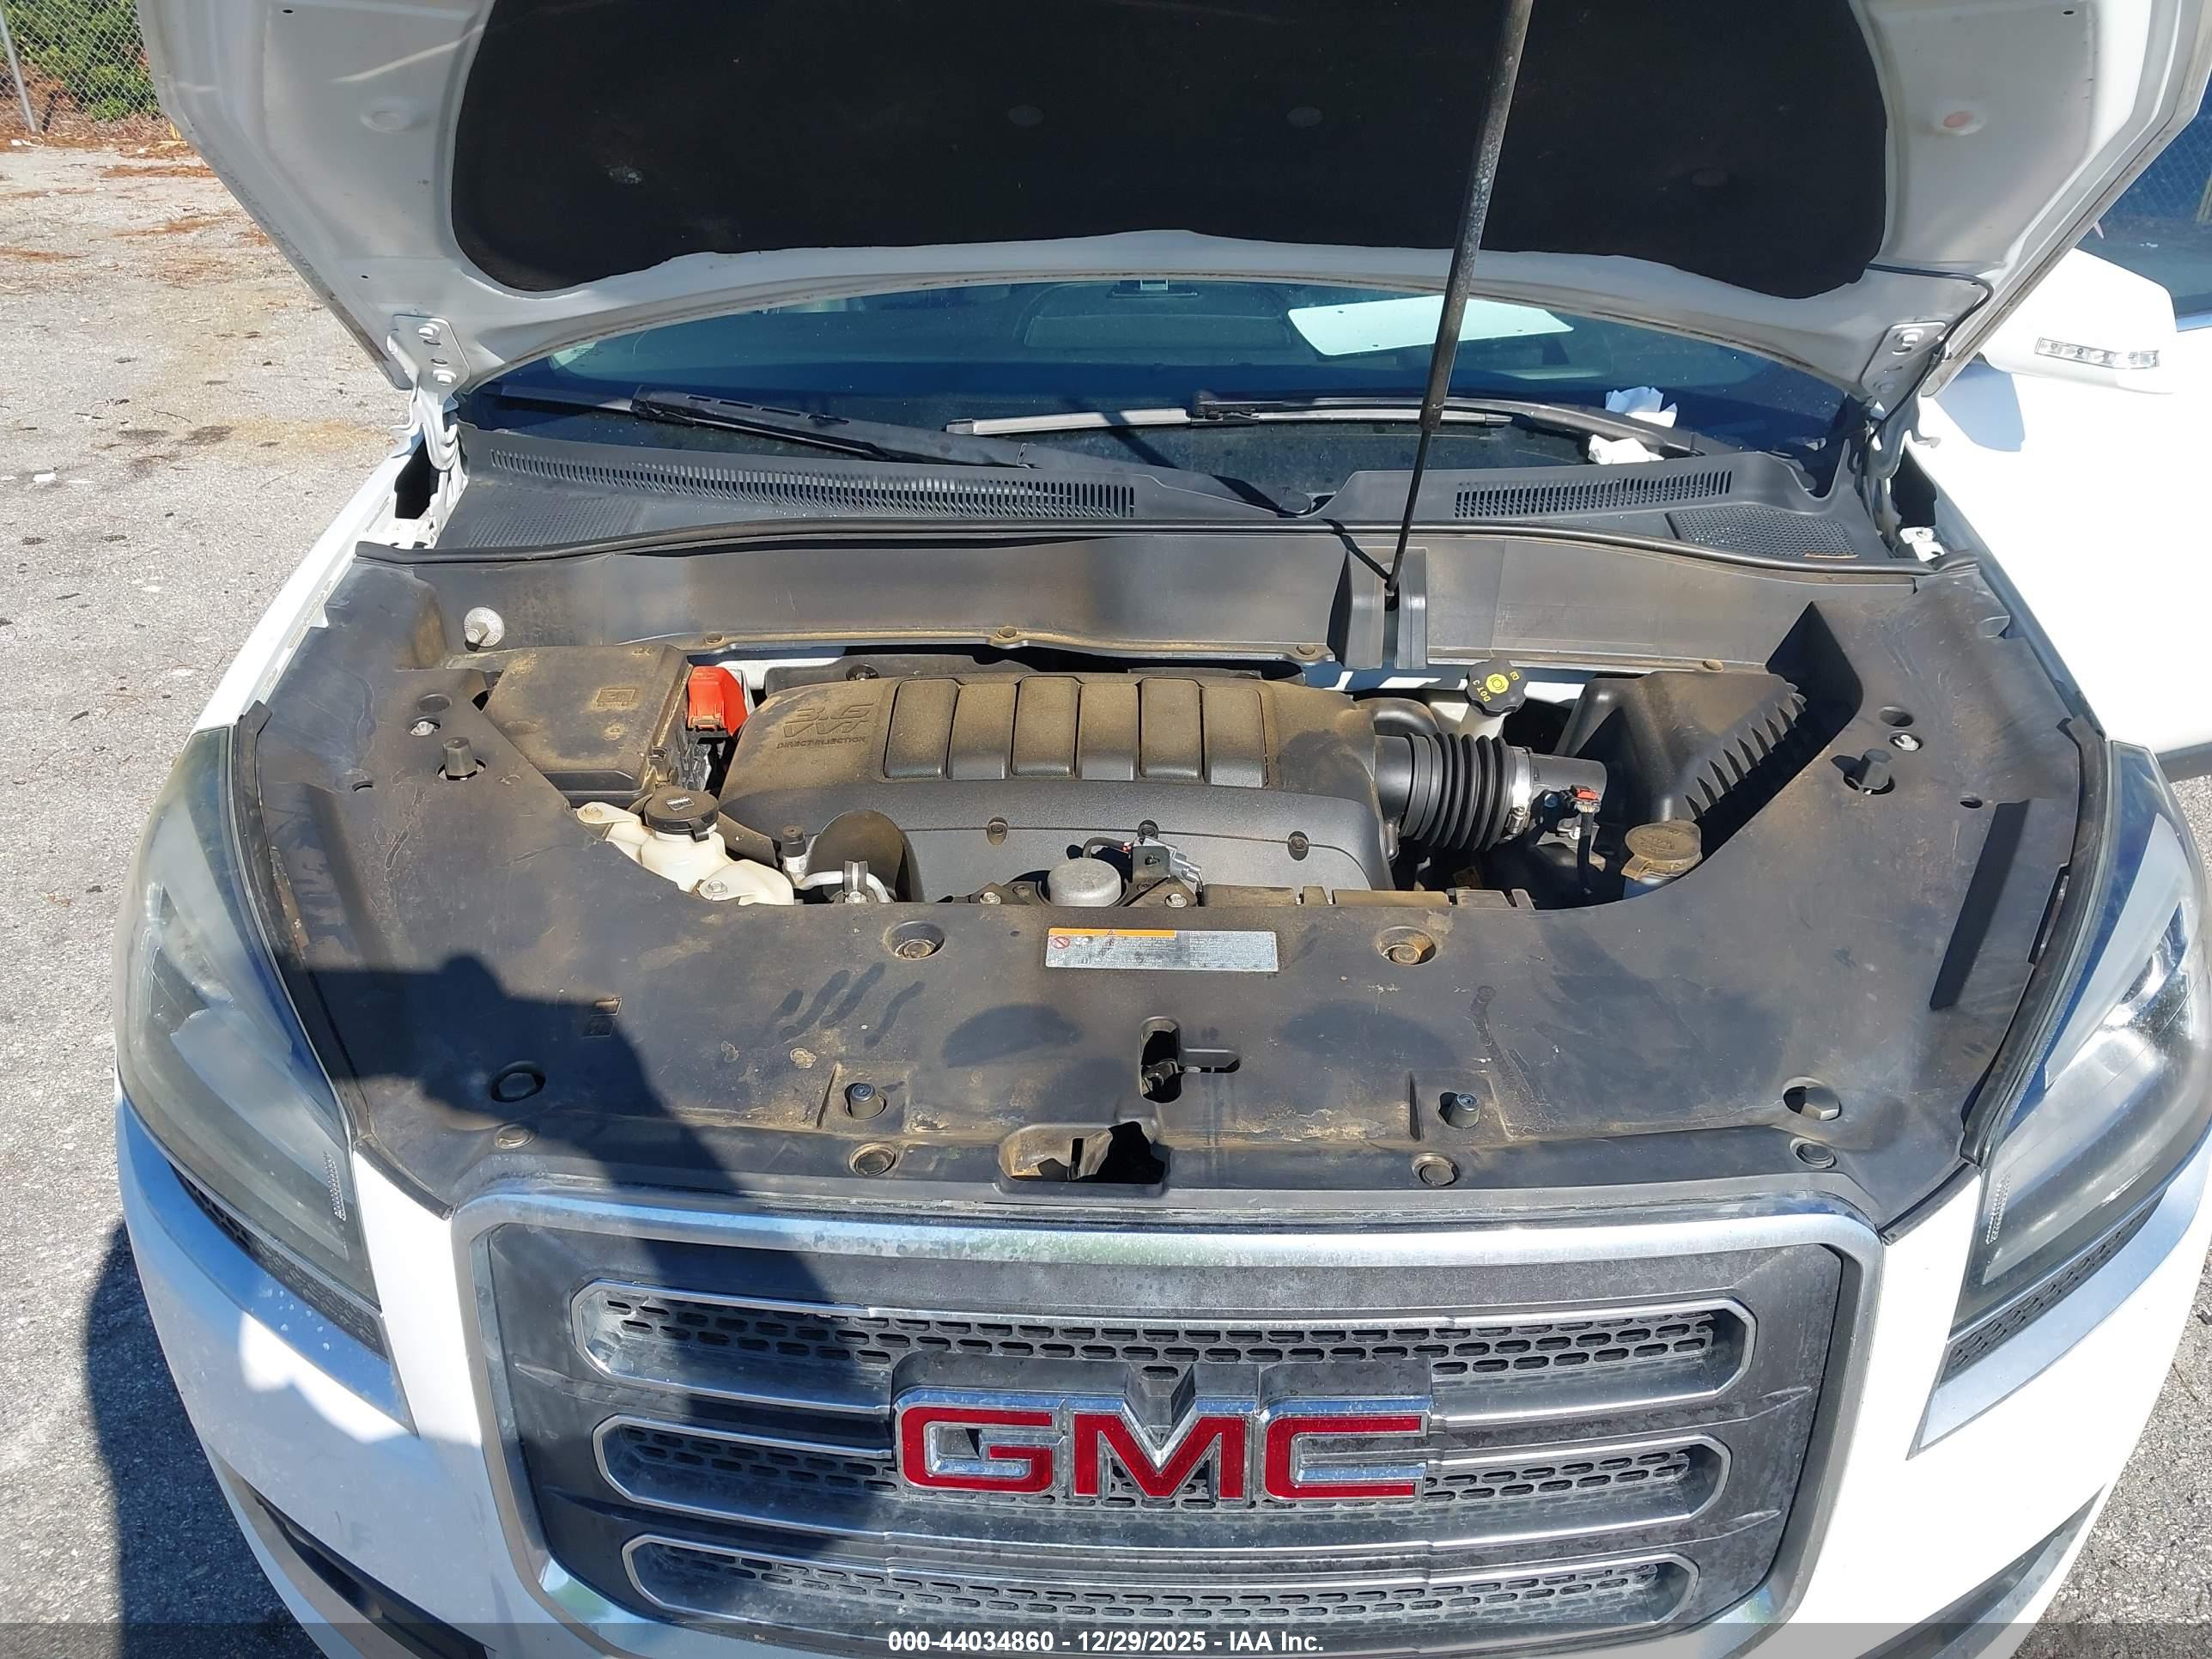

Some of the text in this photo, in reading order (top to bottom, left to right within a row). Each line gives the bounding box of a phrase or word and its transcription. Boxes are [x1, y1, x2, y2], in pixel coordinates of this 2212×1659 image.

[1477, 687, 1492, 702] DOT
[776, 736, 866, 750] DIRECT INJECTION
[895, 1388, 1431, 1503] GMC
